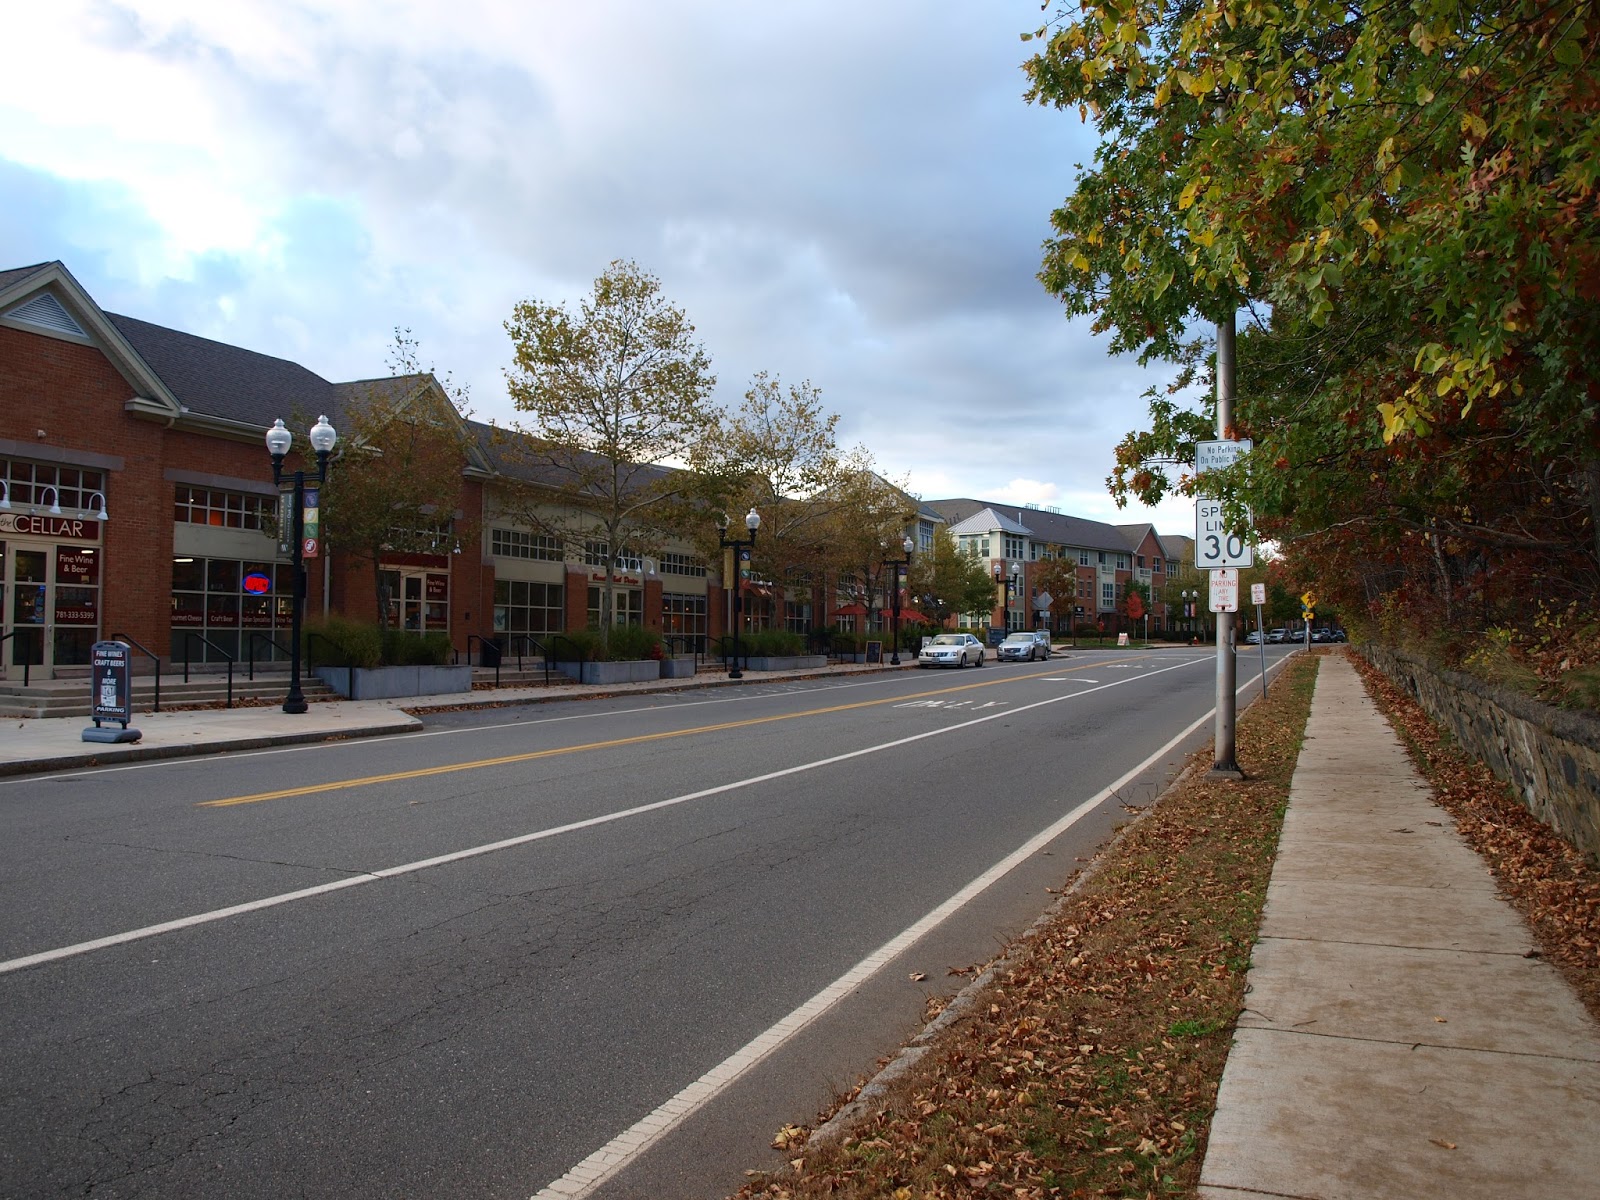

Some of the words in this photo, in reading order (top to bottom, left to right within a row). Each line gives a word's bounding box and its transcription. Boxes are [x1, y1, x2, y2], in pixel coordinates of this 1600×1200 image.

[1207, 446, 1216, 454] No
[1218, 445, 1241, 455] Parking
[1200, 456, 1209, 465] On
[1211, 455, 1230, 463] Public
[0, 518, 11, 527] the
[13, 515, 83, 537] CELLAR
[1204, 534, 1244, 560] 30
[60, 553, 74, 563] Fine
[75, 555, 93, 564] Wine
[72, 565, 88, 573] Beer
[56, 610, 95, 619] 781-333-5399
